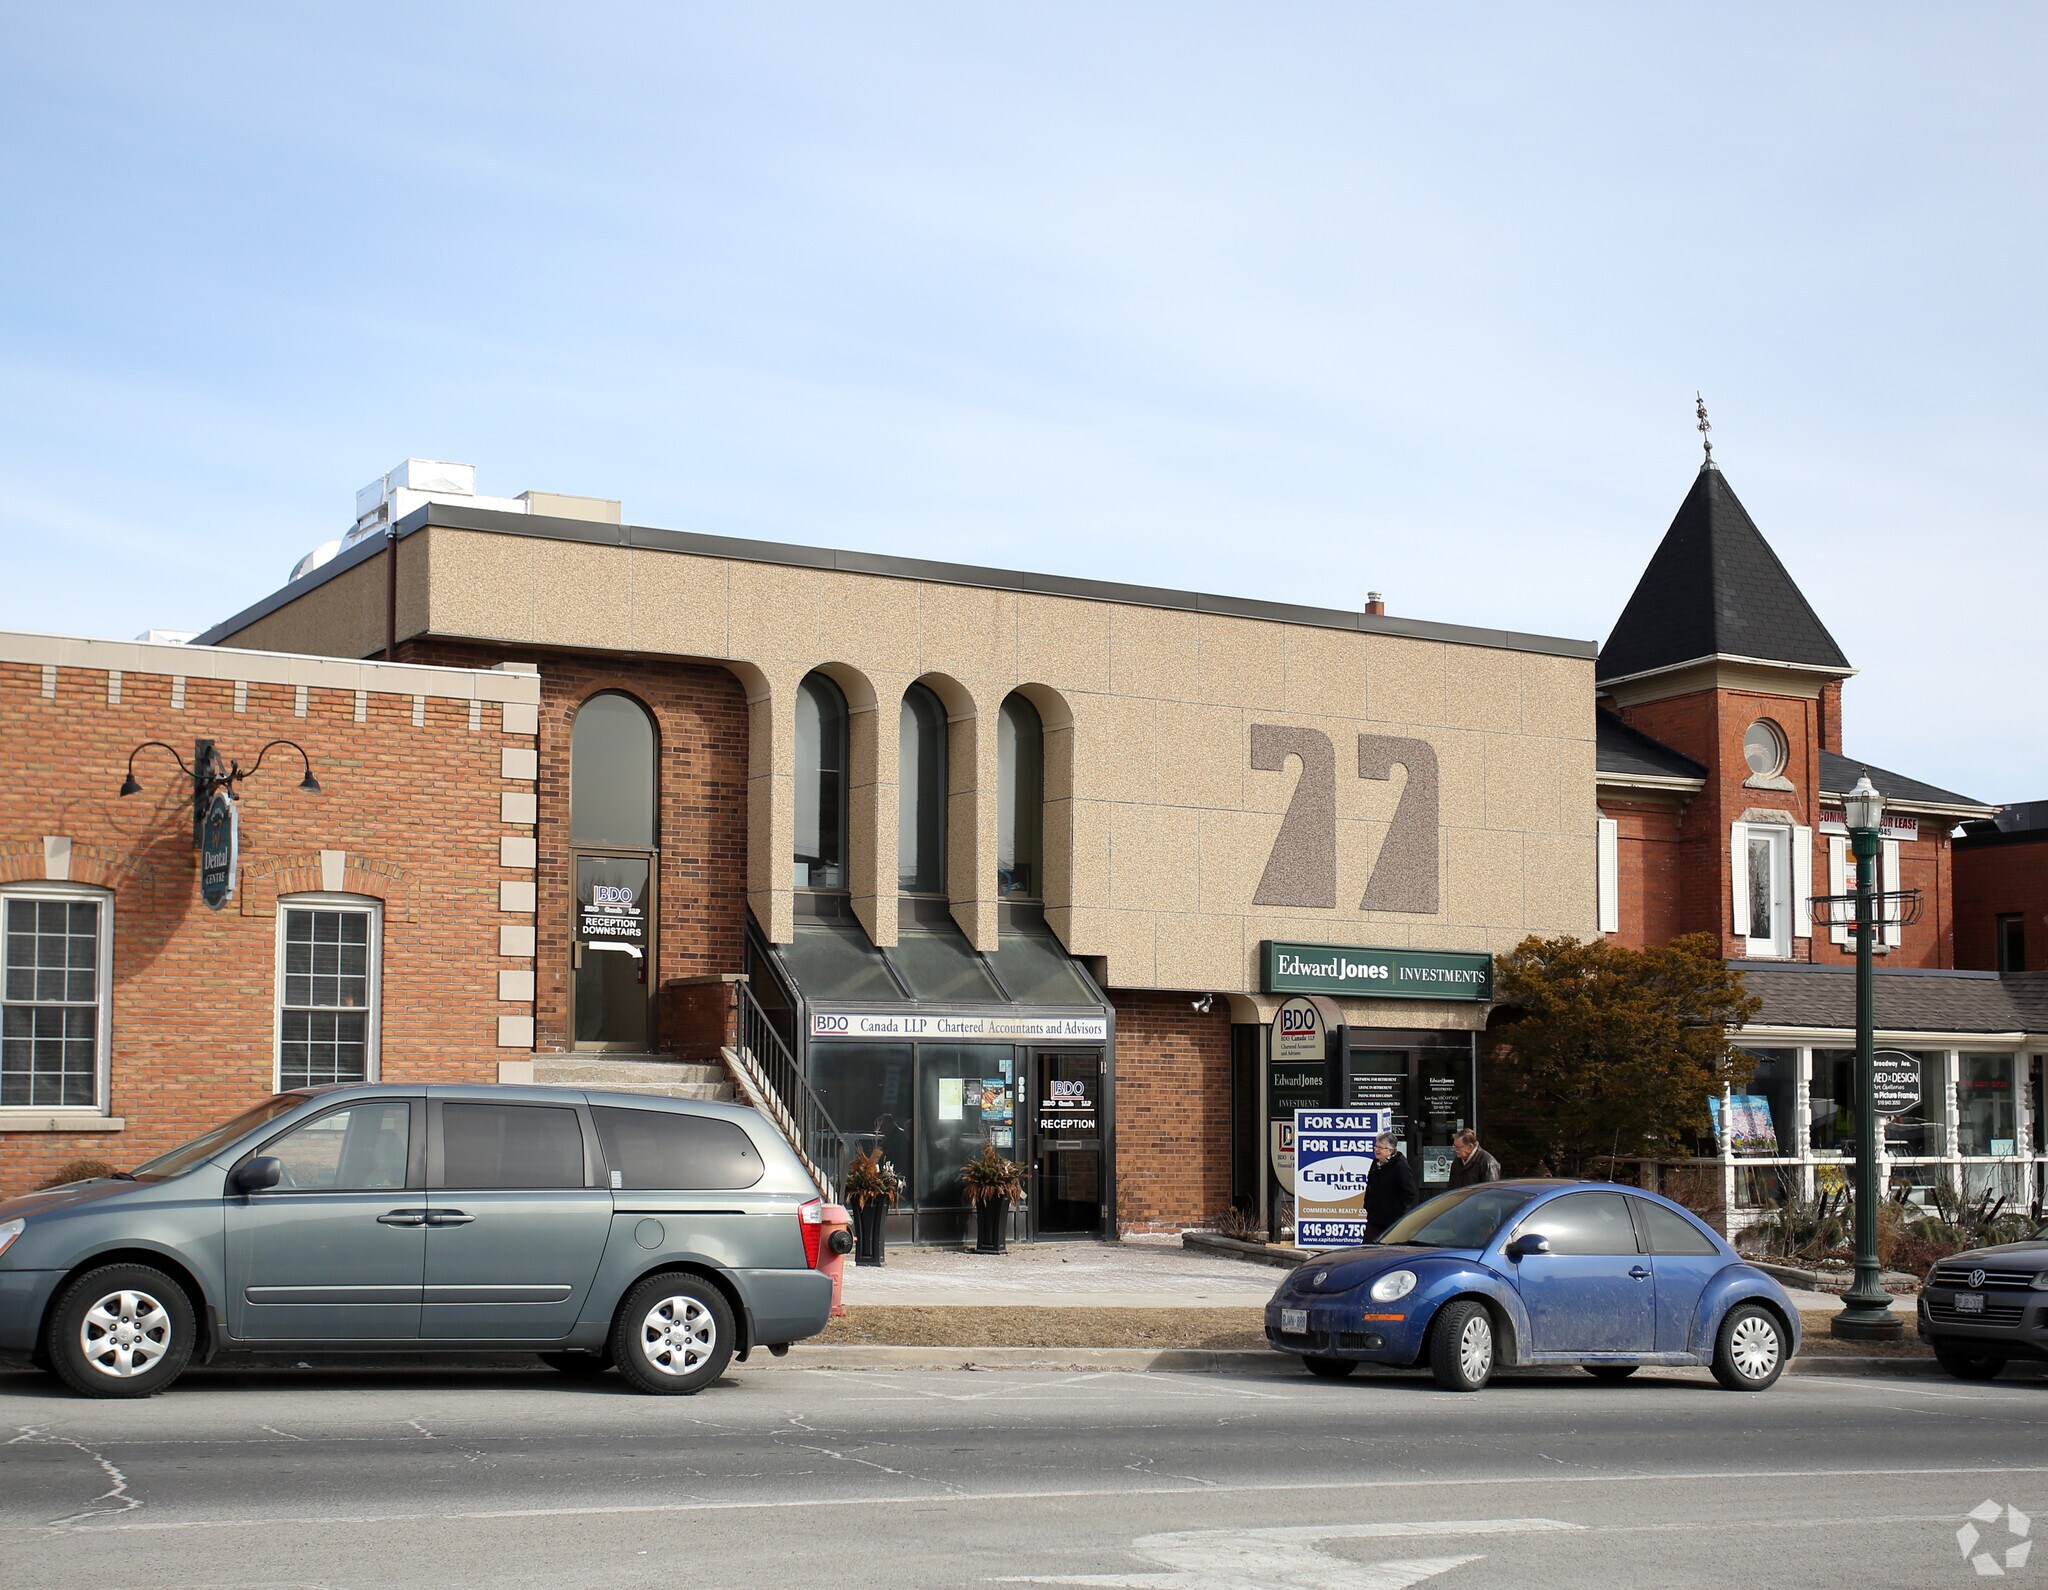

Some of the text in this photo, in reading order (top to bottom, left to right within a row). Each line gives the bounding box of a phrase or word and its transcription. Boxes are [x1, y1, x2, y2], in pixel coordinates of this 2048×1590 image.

[1895, 817, 1917, 830] LEASE
[205, 846, 228, 870] Dental
[206, 872, 225, 885] CENTRE
[598, 885, 633, 903] BDO
[585, 917, 637, 927] RECEPTION
[582, 926, 642, 936] DOWNSTAIRS
[1399, 966, 1486, 984] INVESTMENTS
[817, 1016, 1103, 1035] BDO Canada LLP Chartered Accountants and Advisors
[1283, 1008, 1316, 1031] BDO
[1873, 1060, 1898, 1068] Broadway
[1055, 1080, 1085, 1096] BDO
[1879, 1091, 1897, 1099] Picture
[1897, 1091, 1919, 1101] Framing
[1279, 1099, 1320, 1108] INVESTMENTS
[1040, 1119, 1095, 1129] RECEPTION
[1304, 1116, 1333, 1129] FOR
[1335, 1116, 1371, 1129] SALE
[1392, 1126, 1404, 1134] PEN
[1302, 1139, 1374, 1152] FOR LEASE
[1303, 1170, 1367, 1185] Capita
[1334, 1183, 1365, 1191] North
[1302, 1223, 1367, 1237] 416-987-750
